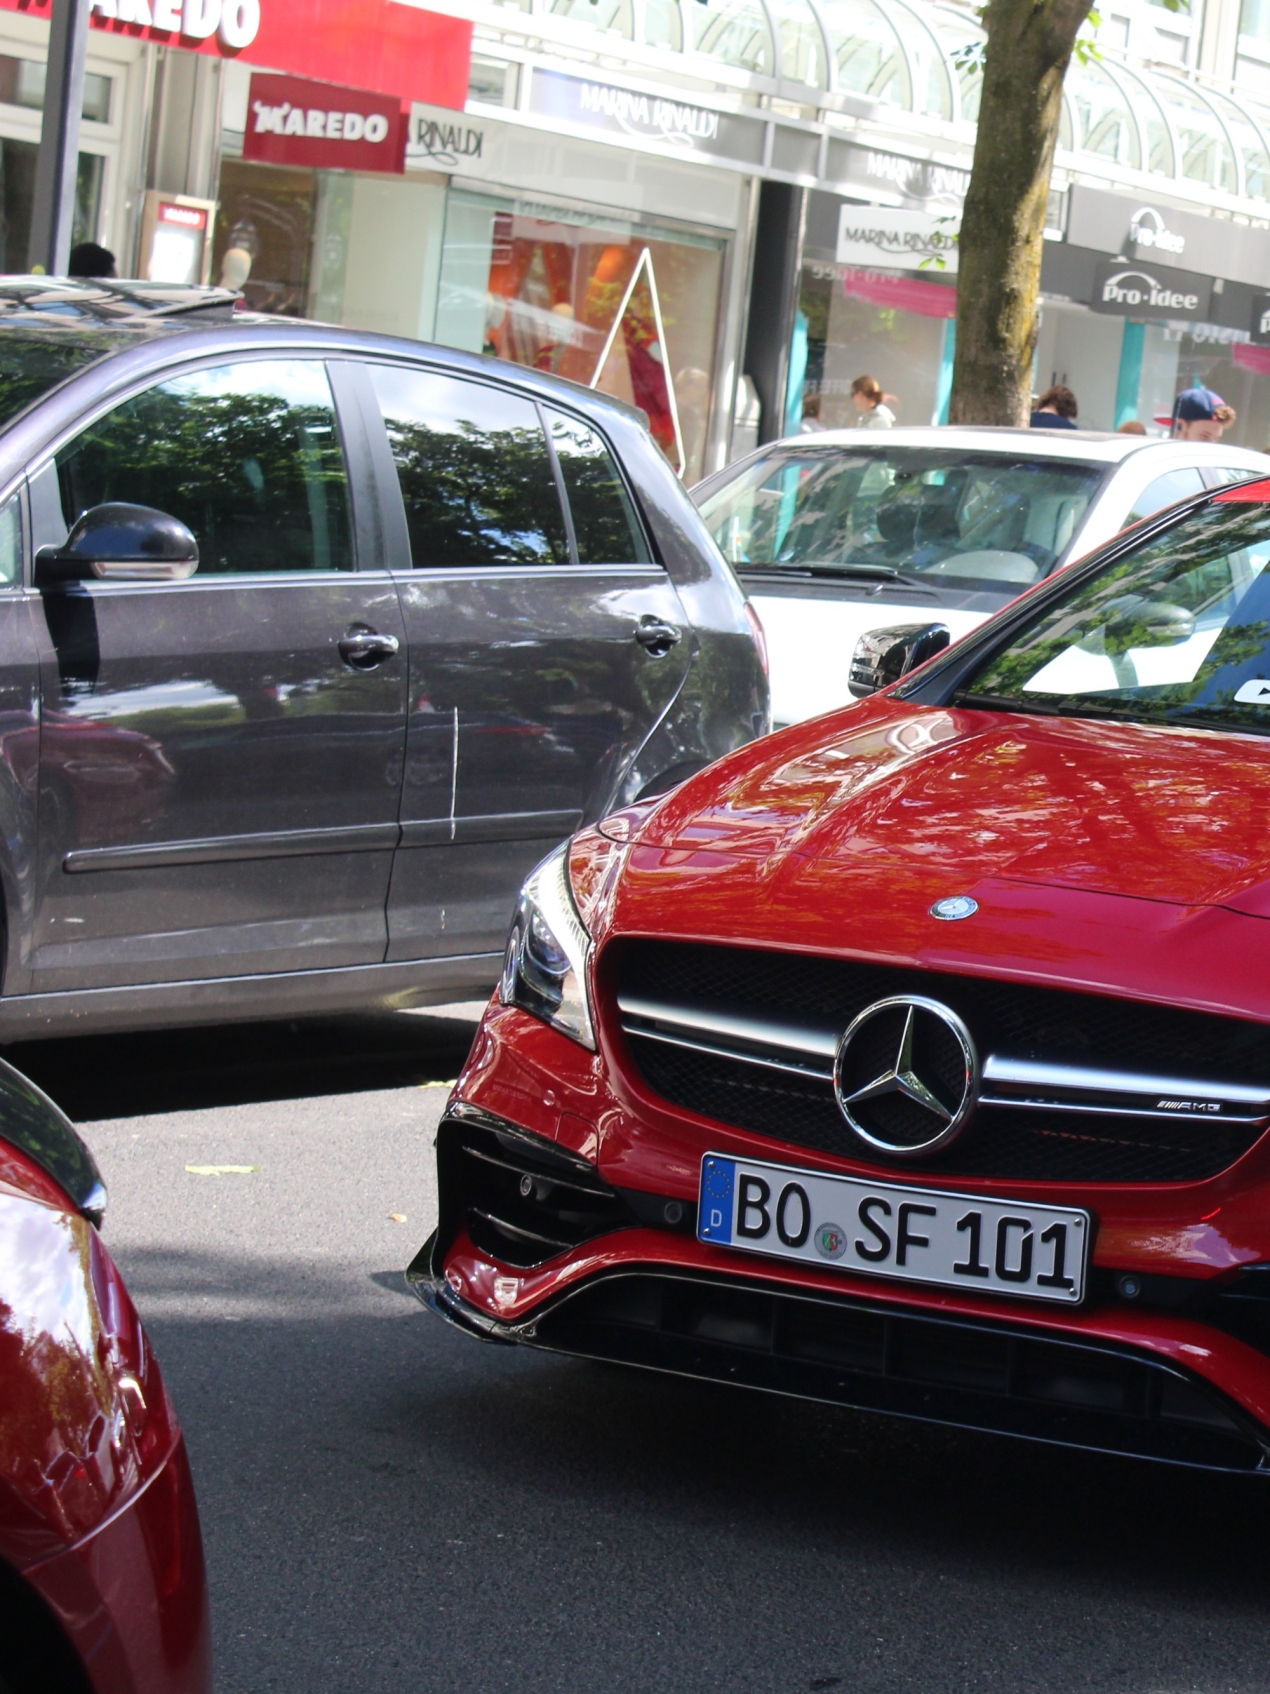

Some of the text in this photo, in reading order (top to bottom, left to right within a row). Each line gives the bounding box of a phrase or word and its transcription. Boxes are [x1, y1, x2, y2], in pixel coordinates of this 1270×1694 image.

[253, 100, 389, 143] MAREDO
[845, 226, 900, 246] MARINA
[710, 1209, 723, 1227] D
[736, 1173, 811, 1249] BO
[854, 1195, 938, 1267] SF
[953, 1209, 1075, 1290] 101
